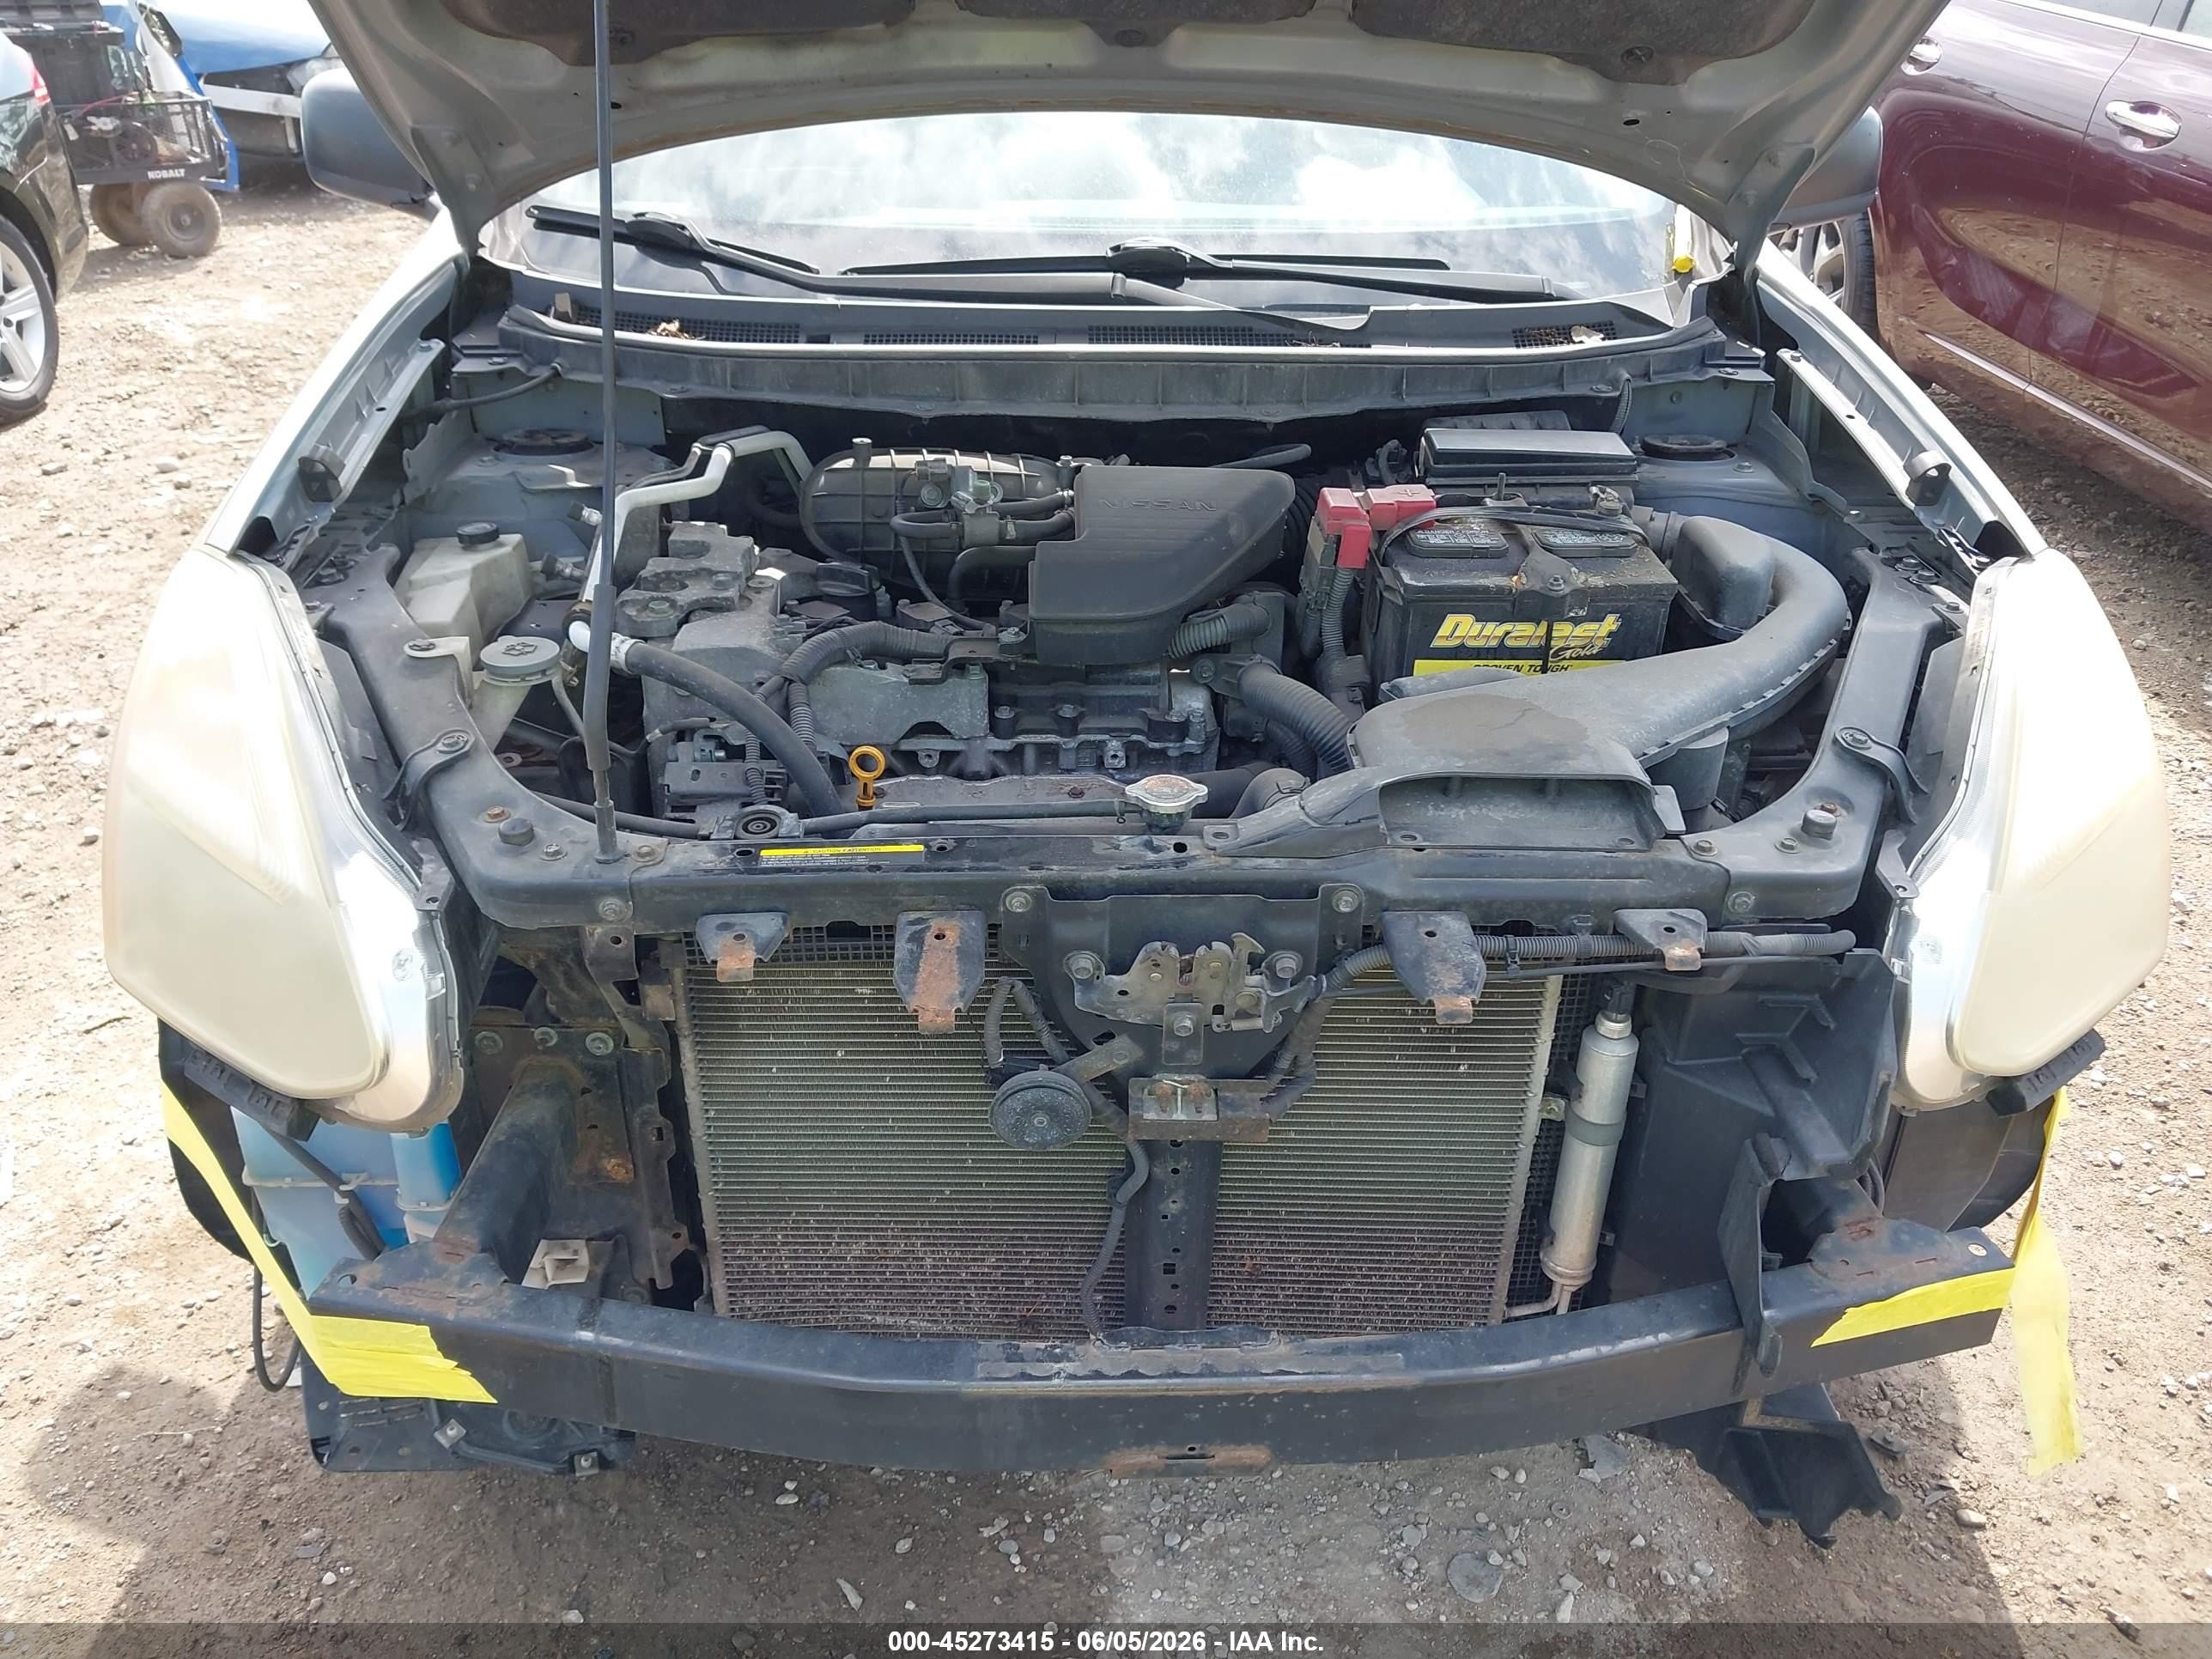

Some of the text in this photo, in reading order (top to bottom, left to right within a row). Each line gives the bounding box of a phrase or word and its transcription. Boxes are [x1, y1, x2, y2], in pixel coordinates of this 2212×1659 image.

[147, 168, 185, 179] KOBALT
[1098, 499, 1217, 511] NISSAN
[1430, 613, 1622, 647] Duralast
[1548, 643, 1603, 661] Gold
